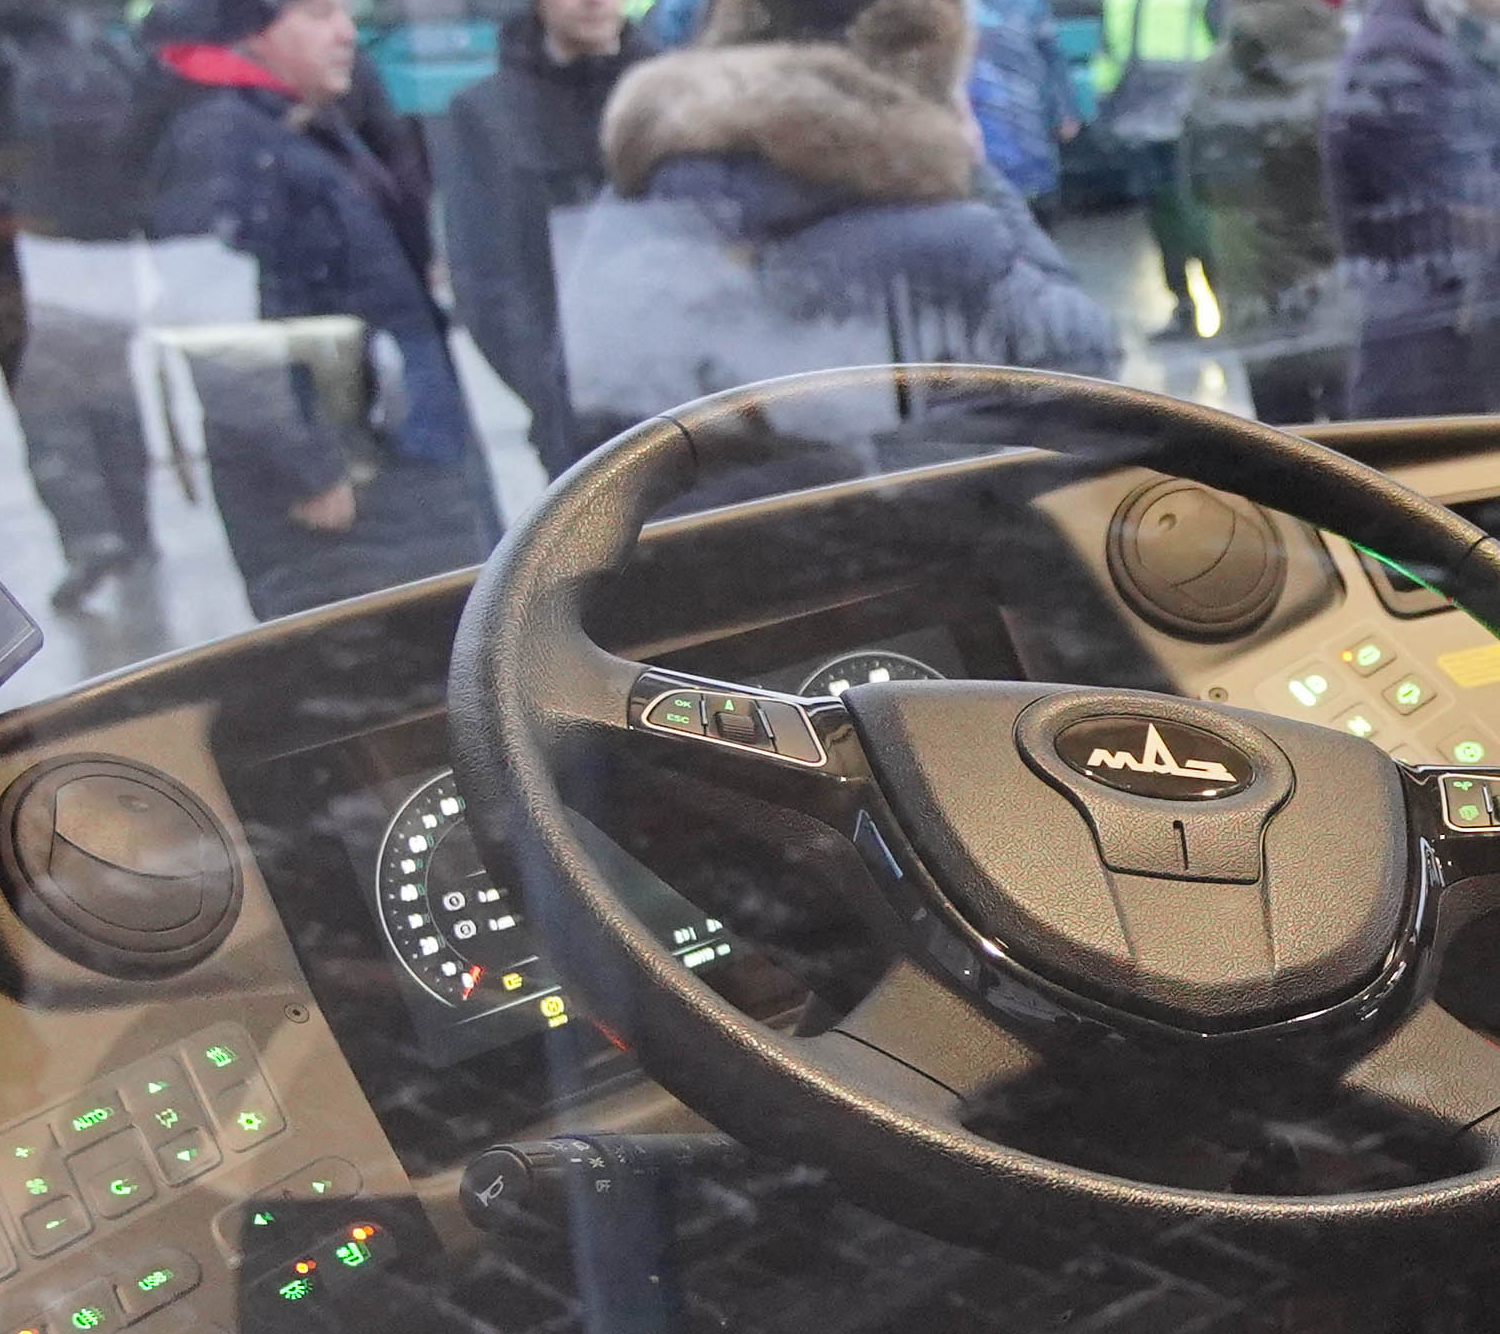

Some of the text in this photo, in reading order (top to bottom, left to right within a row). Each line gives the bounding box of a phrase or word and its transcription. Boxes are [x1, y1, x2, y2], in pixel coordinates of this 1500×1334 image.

[674, 699, 692, 708] OK
[666, 713, 690, 724] ESC
[72, 1108, 108, 1132] AUTO
[138, 1270, 167, 1291] USB
